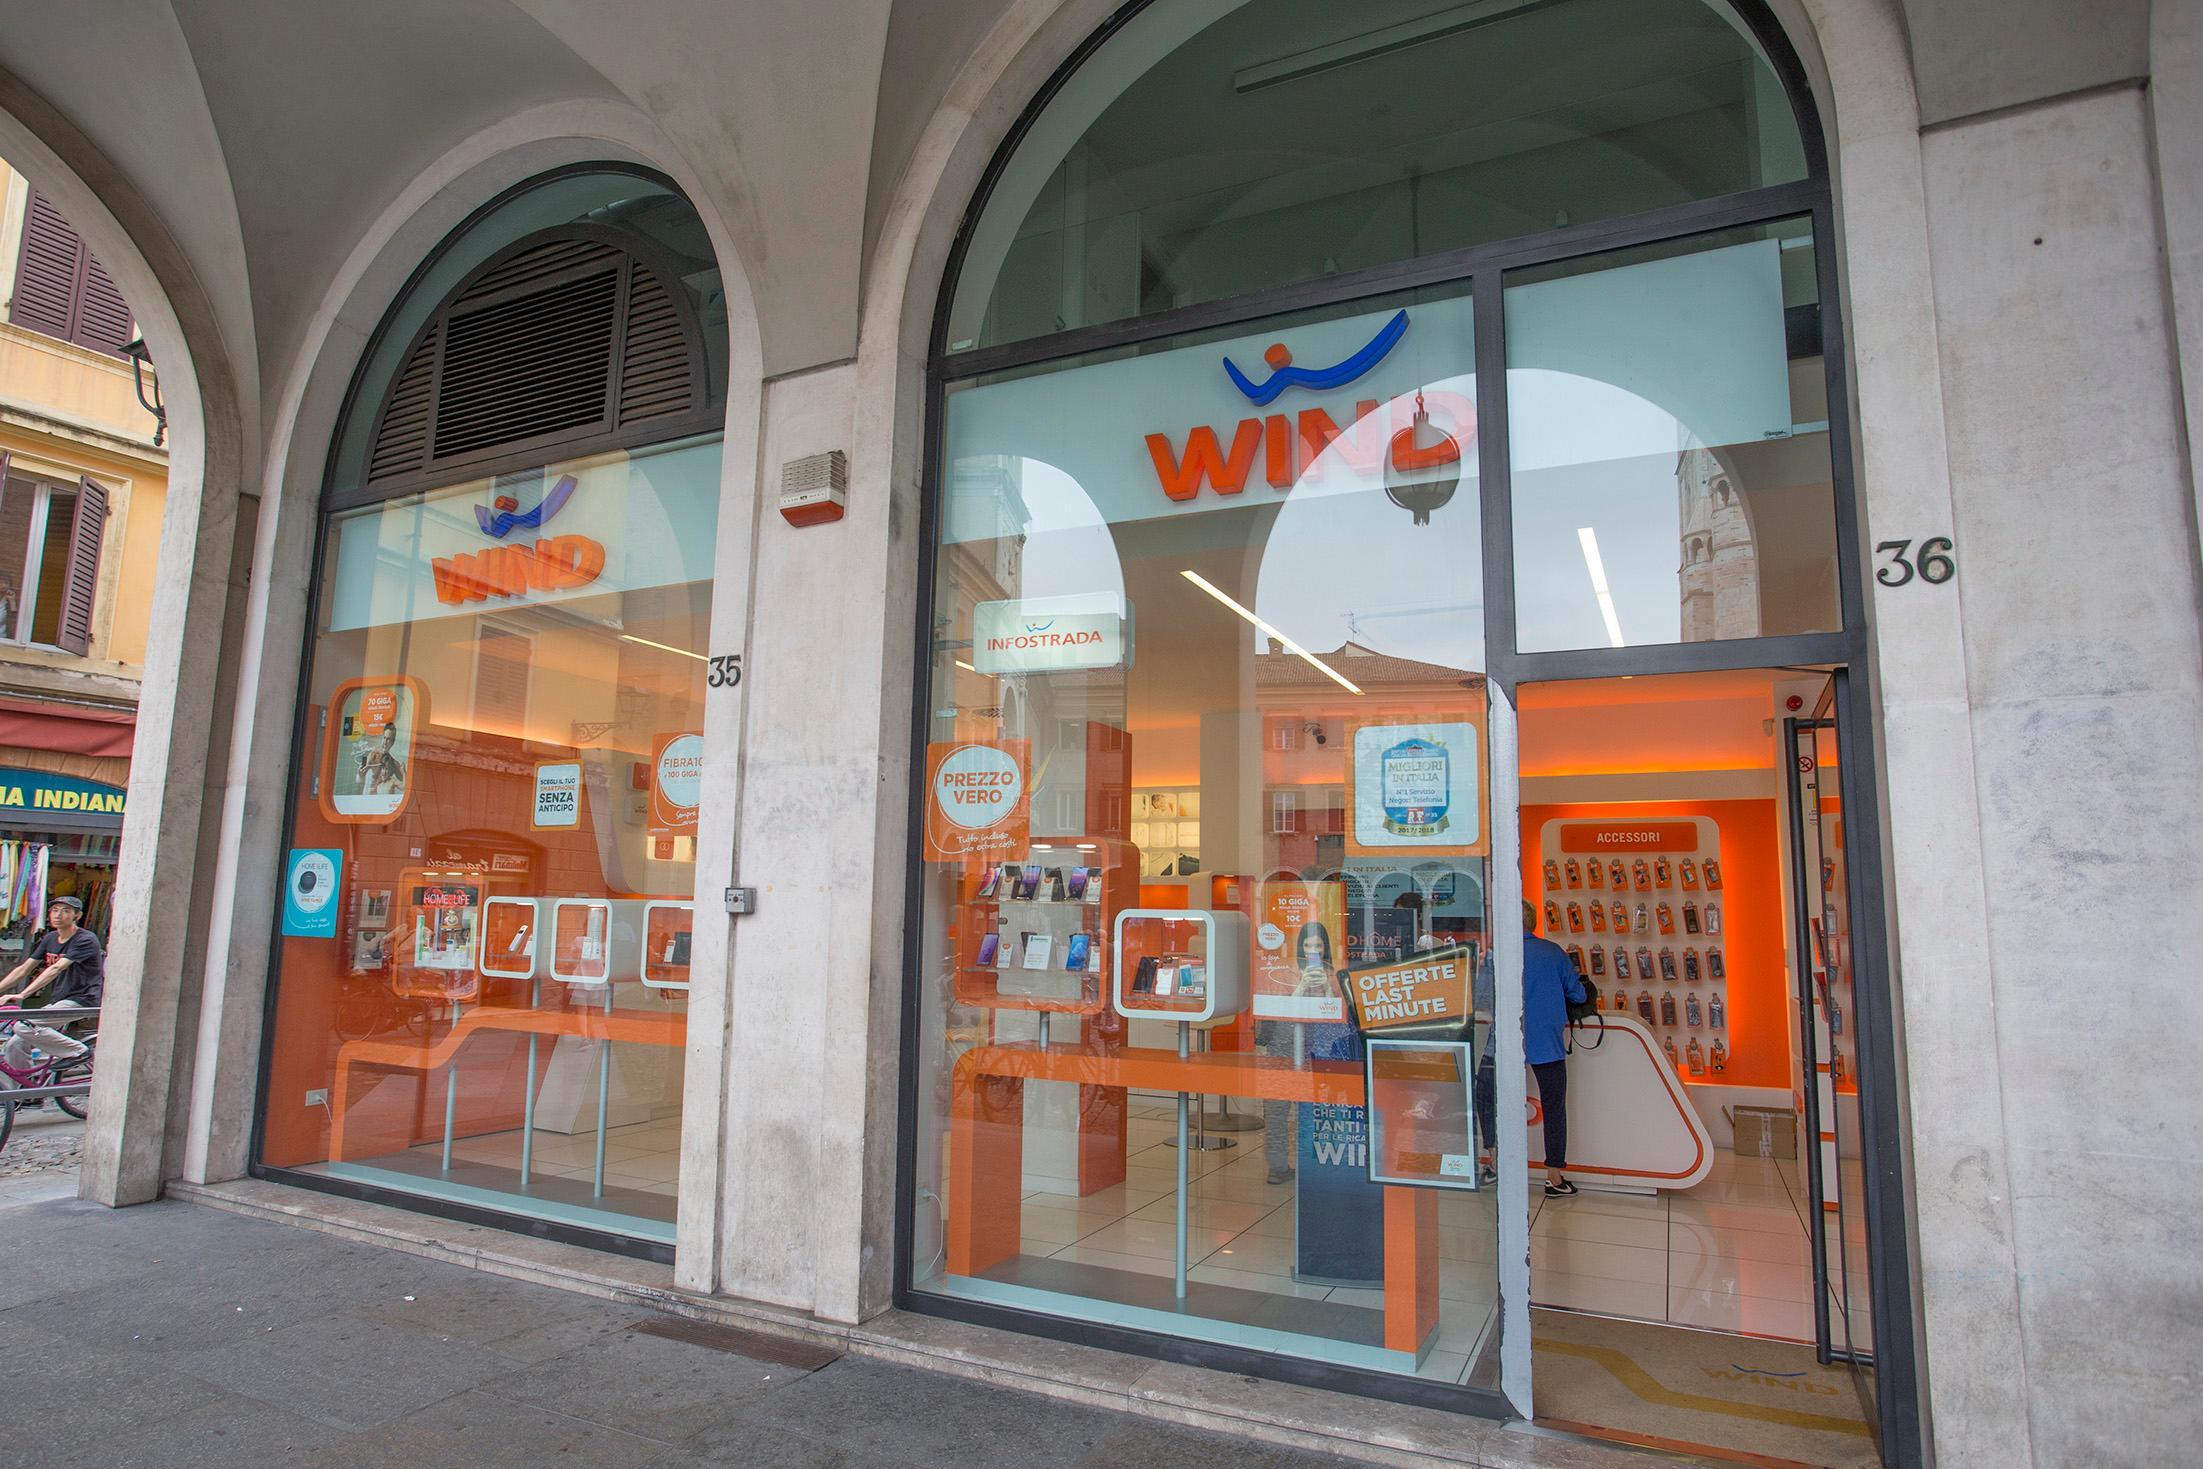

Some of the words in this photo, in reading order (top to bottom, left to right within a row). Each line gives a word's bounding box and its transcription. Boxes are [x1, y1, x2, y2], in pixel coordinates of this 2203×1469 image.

[1144, 389, 1478, 502] WIND
[1876, 537, 1954, 587] 36
[432, 534, 605, 605] WIND
[987, 631, 1103, 651] INFOSTRADA
[708, 654, 741, 687] 35
[1388, 760, 1443, 772] MIGLIORI
[943, 771, 1014, 787] PREZZO
[1392, 774, 1403, 783] IN
[1405, 773, 1440, 783] ITALIA
[539, 792, 574, 803] SENZA
[953, 789, 1002, 805] VERO
[1409, 788, 1436, 796] Servizio
[34, 789, 128, 813] INDIAN
[539, 804, 574, 812] ANTICIPO
[957, 834, 979, 844] Tutto
[981, 831, 1009, 841] incluso
[999, 838, 1017, 849] costi
[1596, 832, 1660, 843] ACCESSORI
[423, 894, 449, 904] HOME
[453, 894, 471, 905] LIFE
[1289, 898, 1309, 906] GIGA
[1359, 963, 1457, 991] OFFERTE
[1361, 986, 1415, 1007] LAST
[1364, 998, 1448, 1022] MINUTE
[1312, 1108, 1336, 1118] CHE
[1341, 1110, 1351, 1119] TI
[1356, 1110, 1365, 1119] R
[1313, 1119, 1360, 1133] TANTI
[1312, 1132, 1329, 1140] PER
[1346, 1134, 1366, 1142] RICA
[1701, 1366, 1840, 1396] WIND
